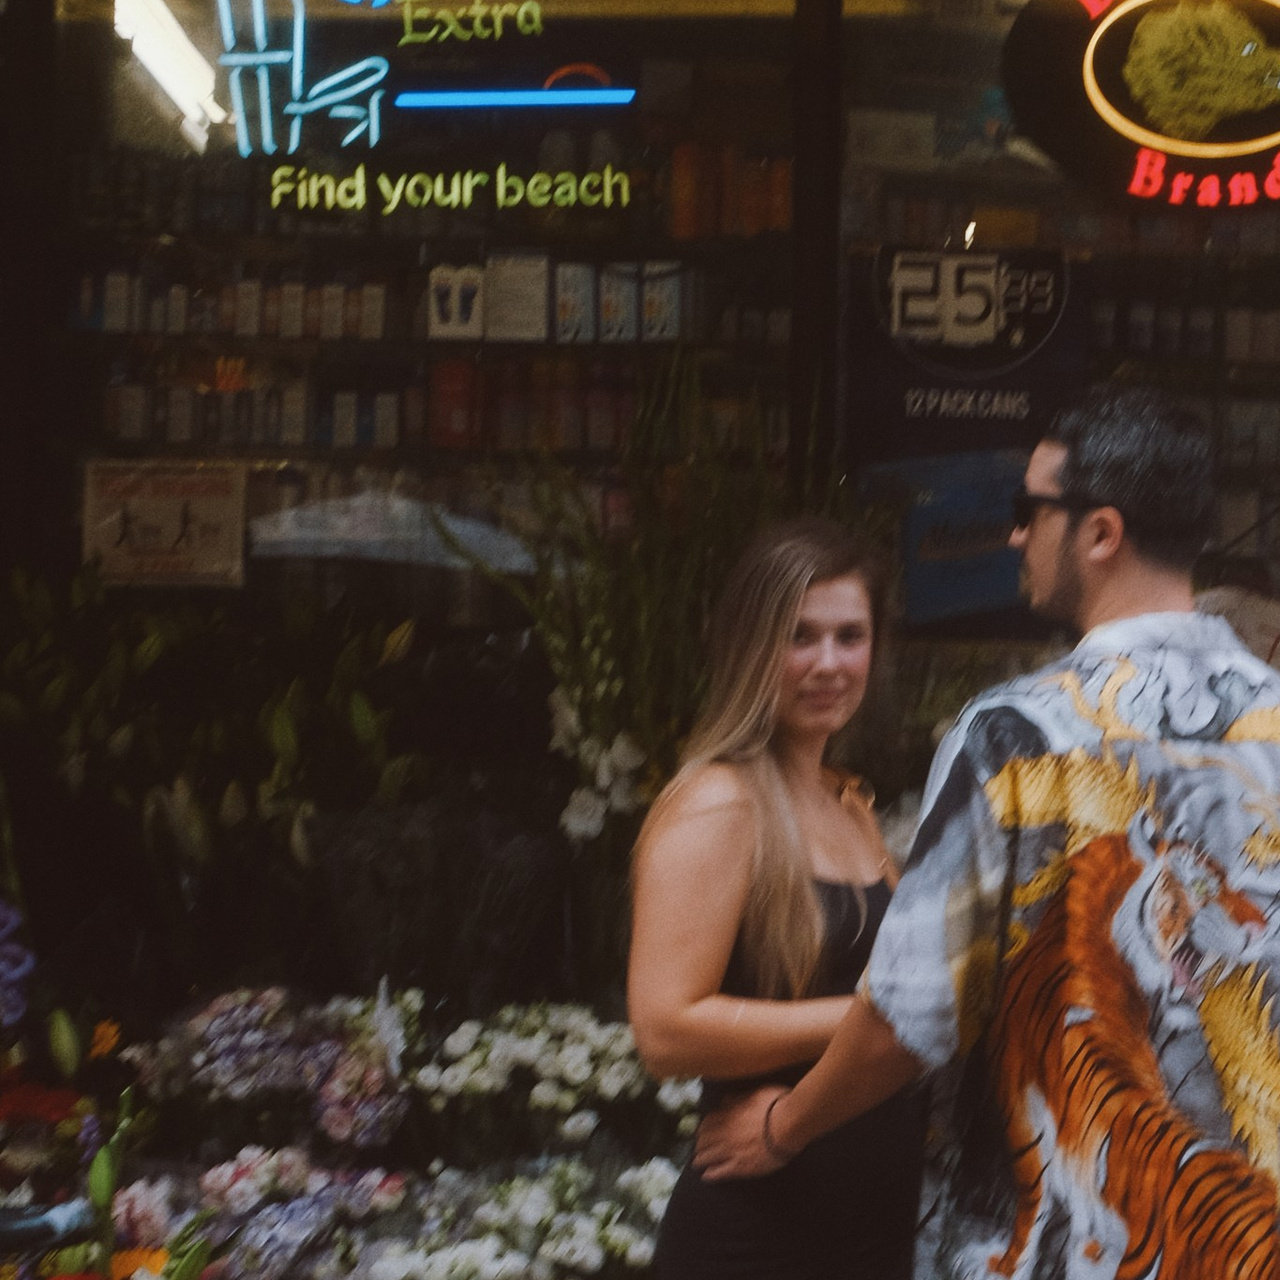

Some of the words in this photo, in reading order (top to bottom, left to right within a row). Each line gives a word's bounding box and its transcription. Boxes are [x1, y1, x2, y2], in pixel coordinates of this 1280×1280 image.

[270, 162, 366, 211] Find
[376, 171, 490, 216] your
[497, 162, 631, 209] beach
[904, 387, 925, 418] 12
[925, 387, 977, 419] PACK
[977, 388, 1032, 421] CANS
